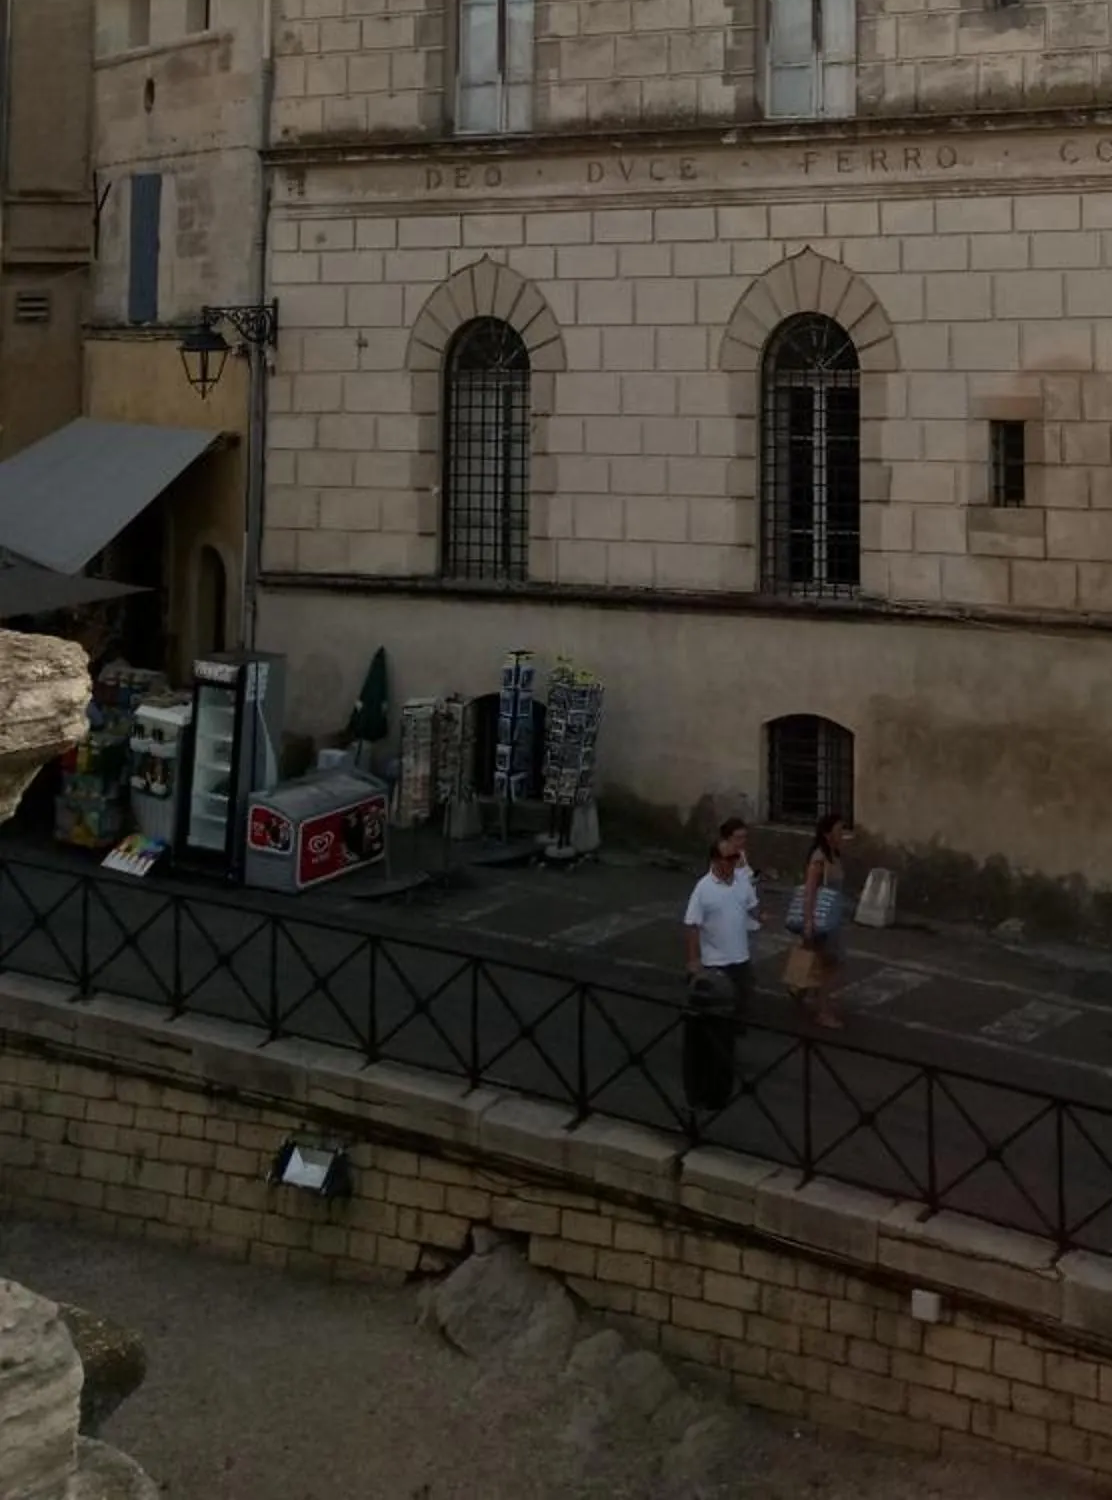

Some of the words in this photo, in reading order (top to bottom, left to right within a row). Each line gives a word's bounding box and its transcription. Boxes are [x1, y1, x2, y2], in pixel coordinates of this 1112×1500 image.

[425, 164, 503, 190] DEO
[586, 157, 698, 184] DVCE
[799, 145, 958, 175] FERRO
